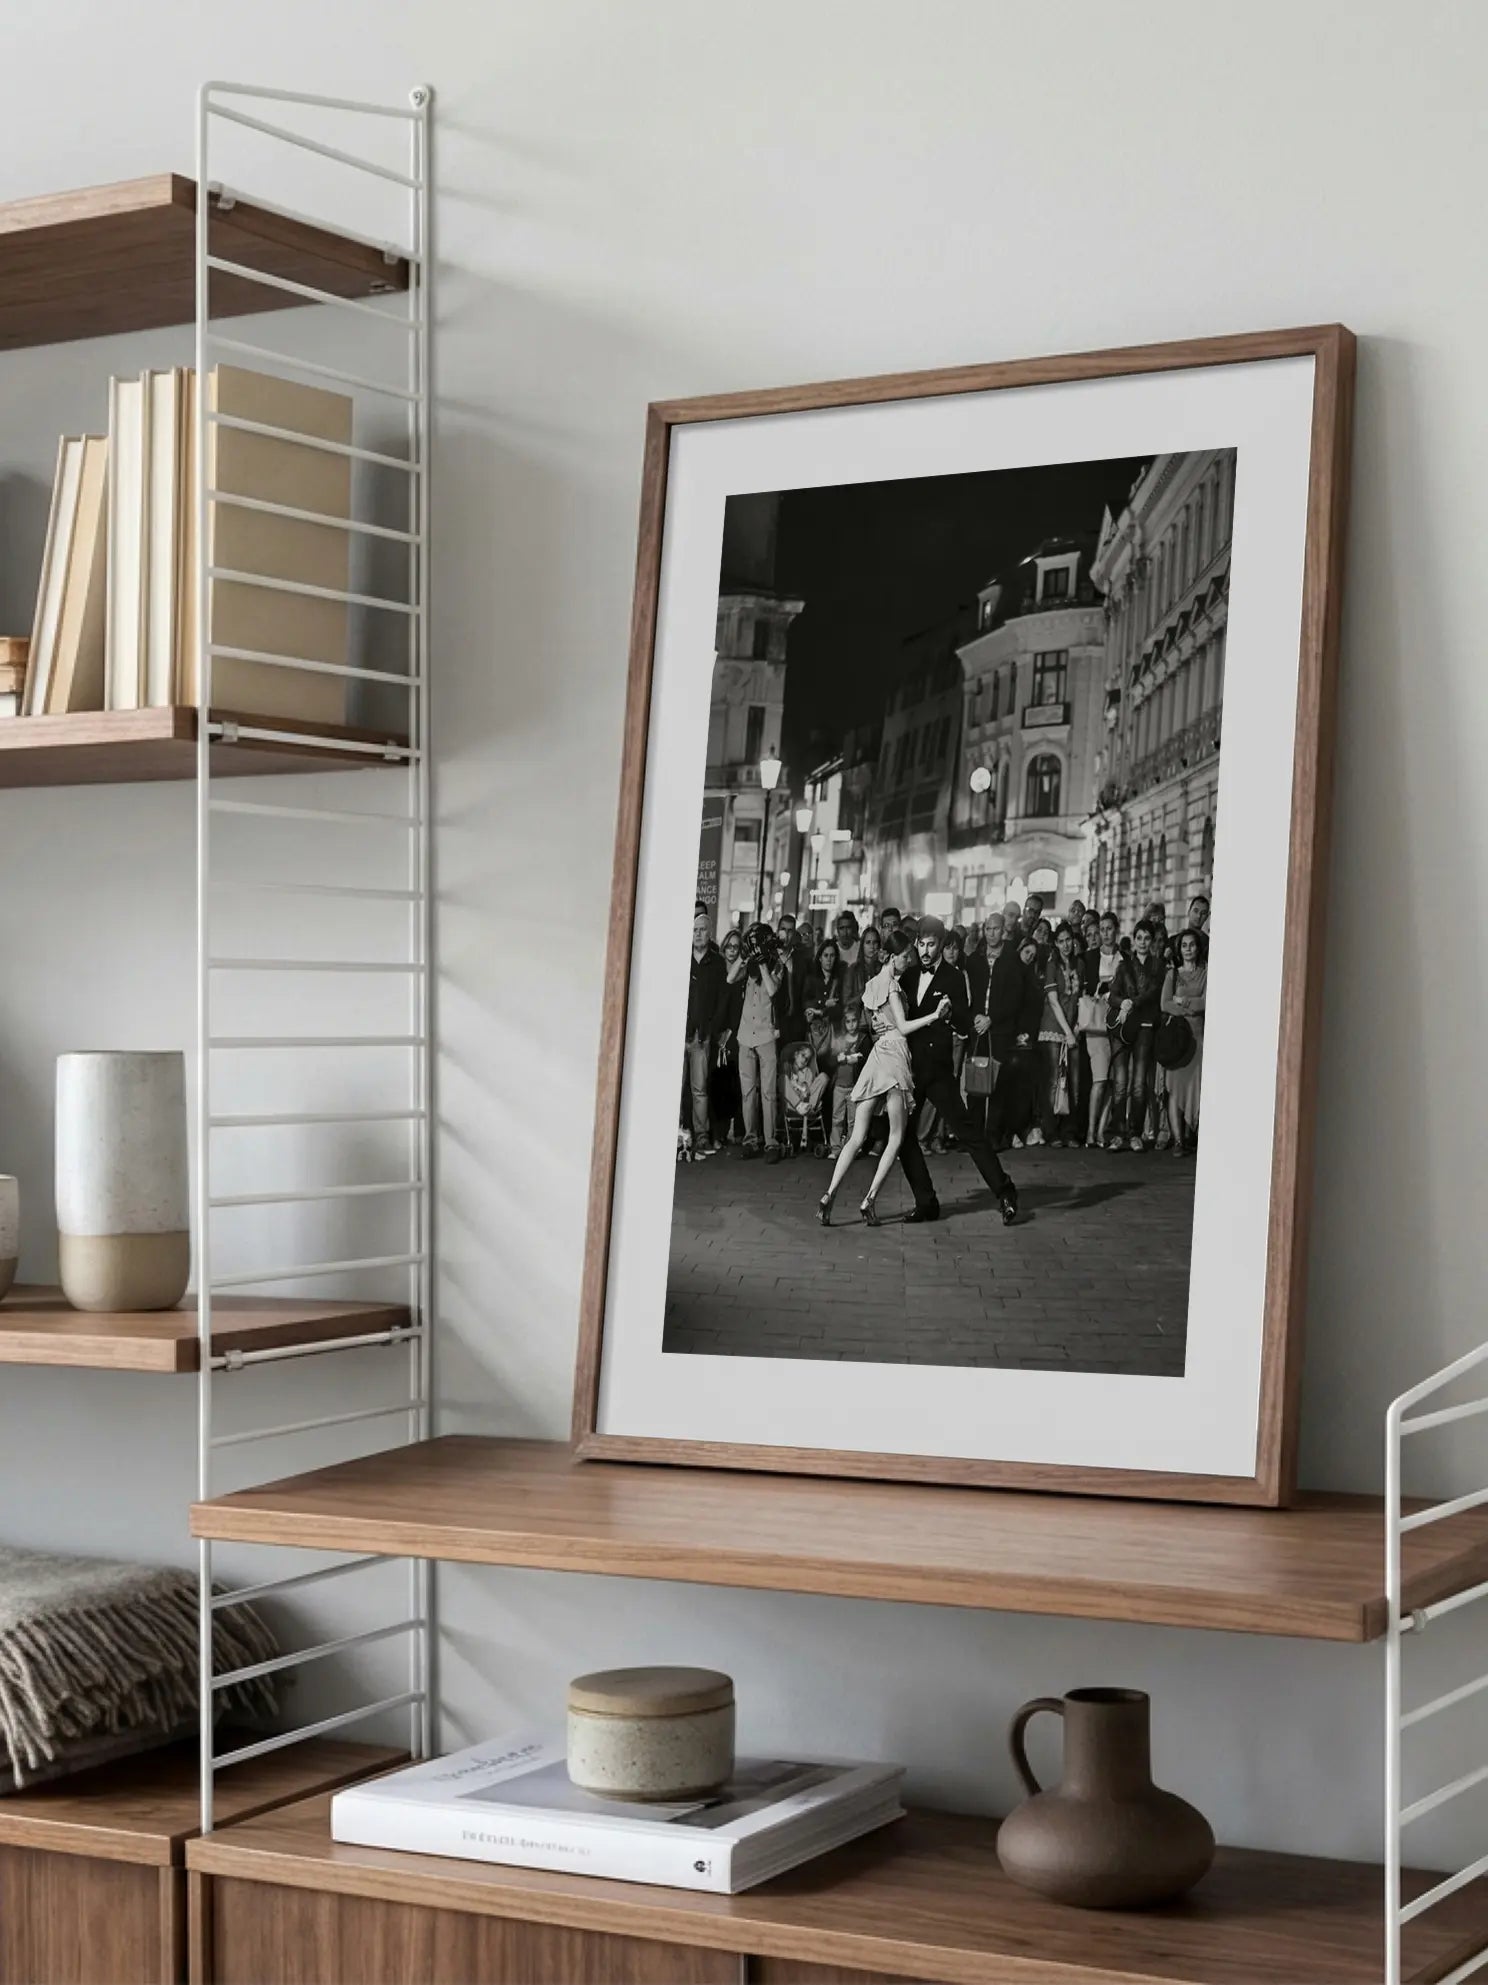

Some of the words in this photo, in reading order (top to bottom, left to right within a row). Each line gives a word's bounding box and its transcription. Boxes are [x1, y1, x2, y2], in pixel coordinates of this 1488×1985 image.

[699, 860, 716, 870] EEP
[698, 871, 716, 880] ALM
[697, 885, 717, 894] ANCE
